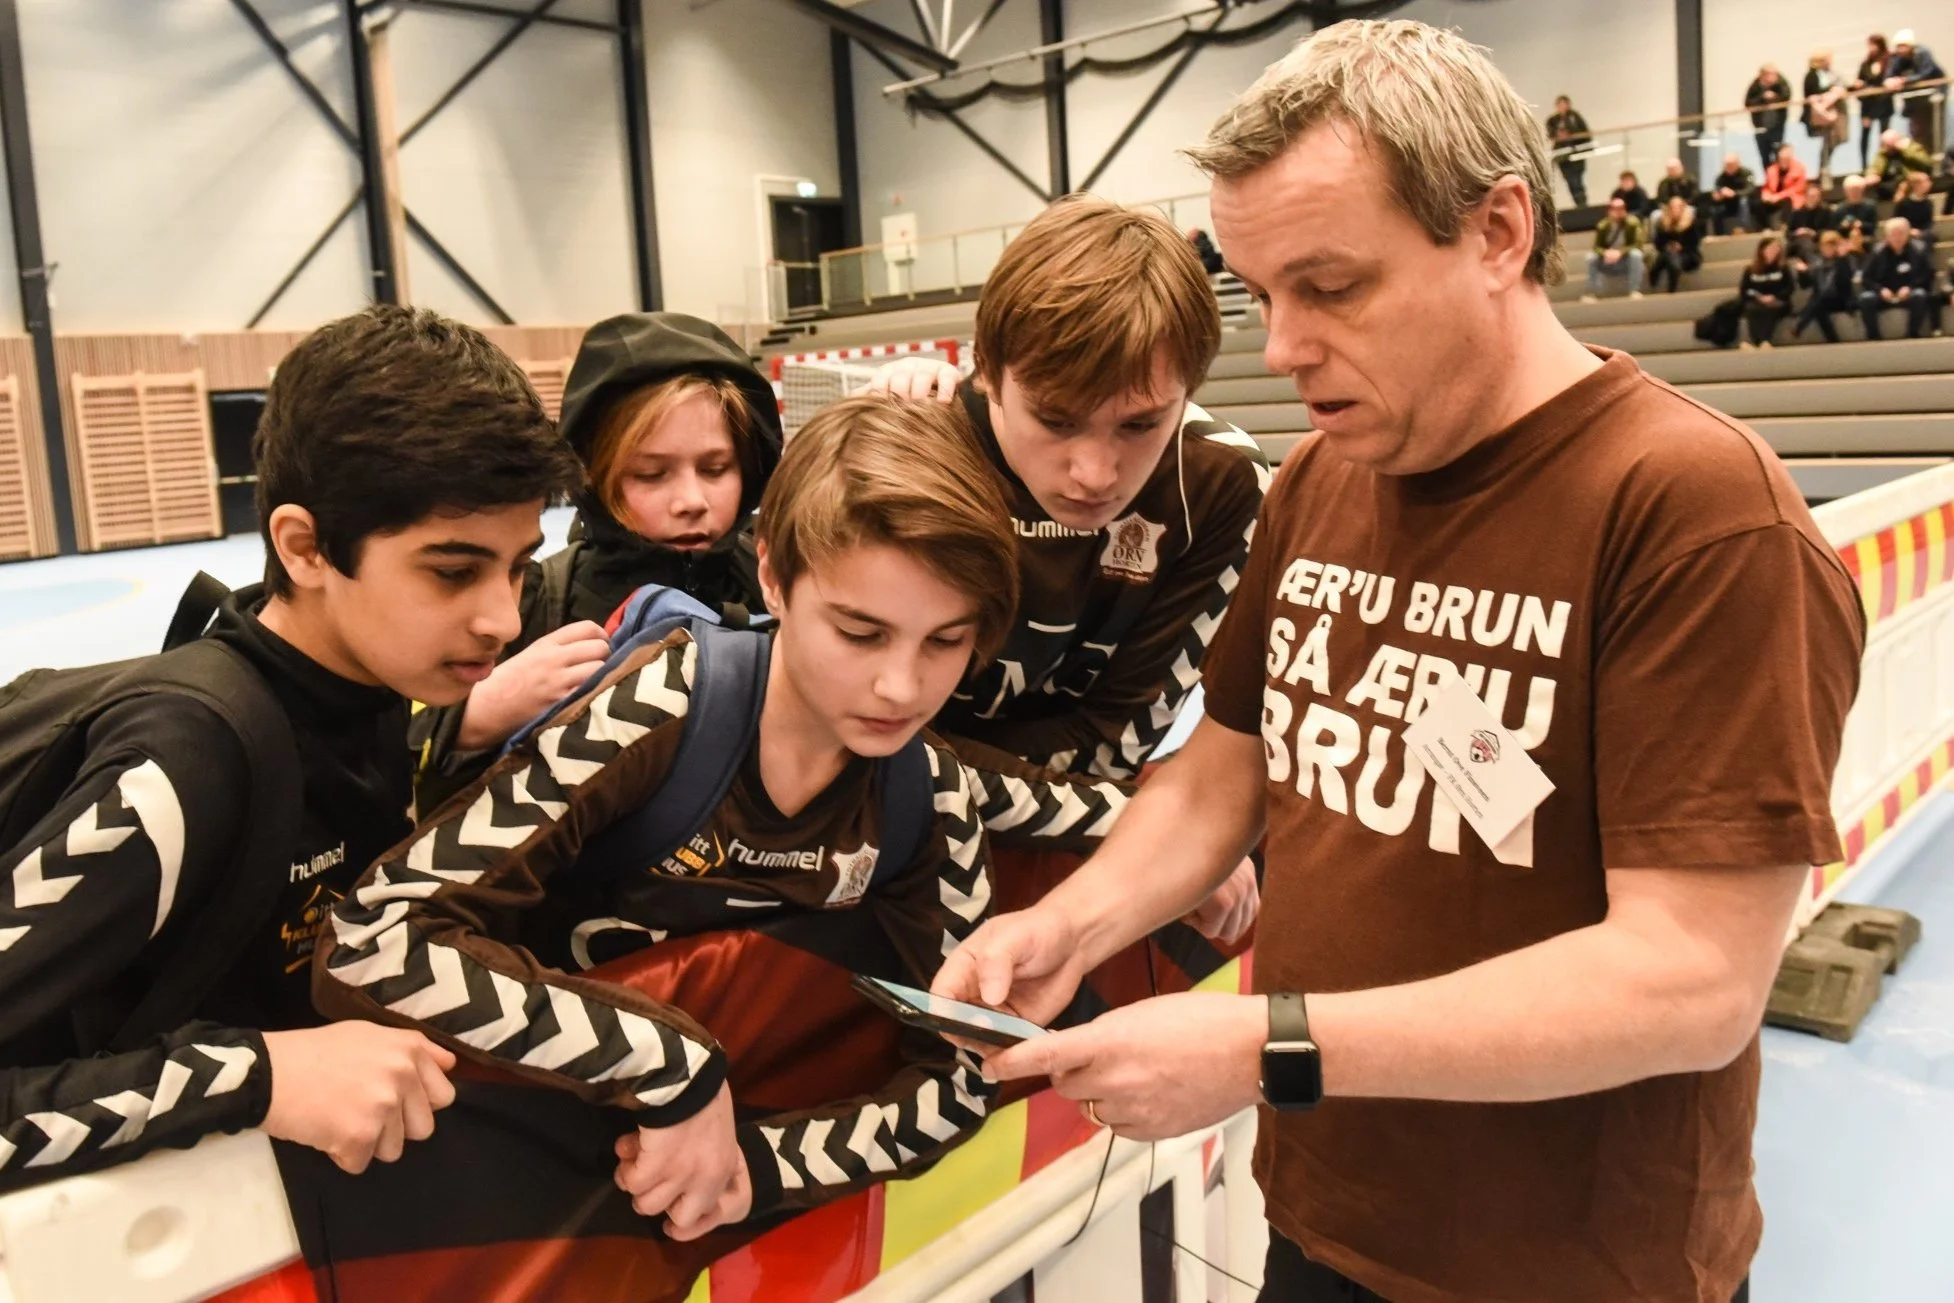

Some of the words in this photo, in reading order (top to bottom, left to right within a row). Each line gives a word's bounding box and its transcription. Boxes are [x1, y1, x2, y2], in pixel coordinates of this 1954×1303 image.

[1276, 558, 1396, 625] ÆR'U
[1404, 581, 1572, 659] BRUN
[1266, 613, 1332, 696] SÅ
[289, 841, 345, 883] hummel
[728, 838, 825, 872] hummel
